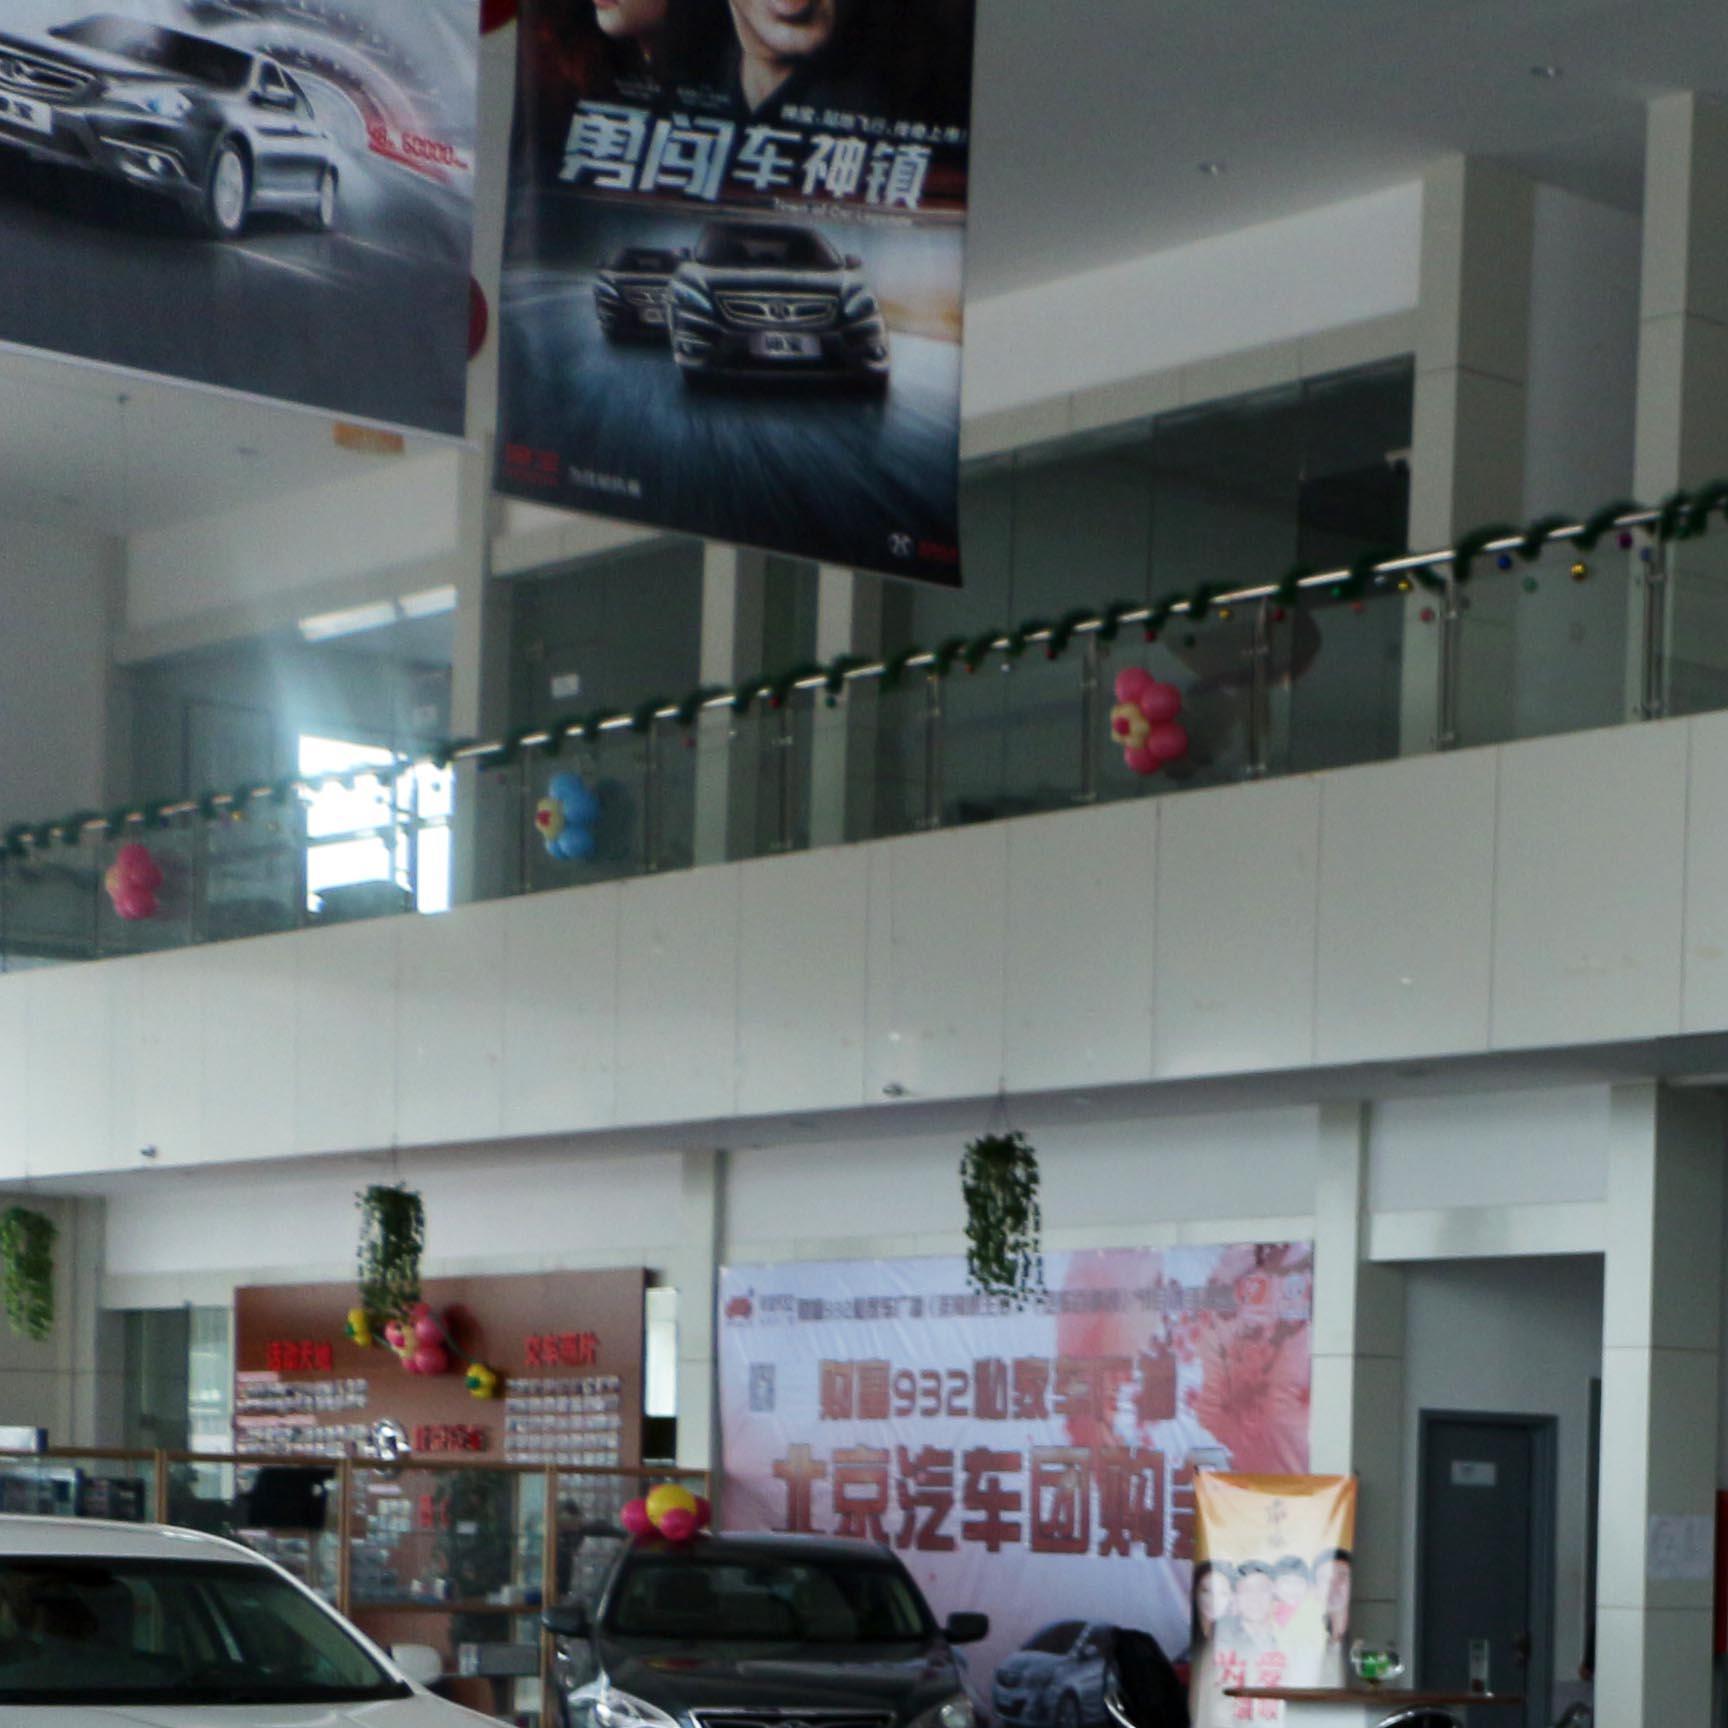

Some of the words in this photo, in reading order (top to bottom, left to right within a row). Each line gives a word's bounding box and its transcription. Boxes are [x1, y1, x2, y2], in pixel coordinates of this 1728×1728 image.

[557, 99, 933, 211] 勇闯车神镇
